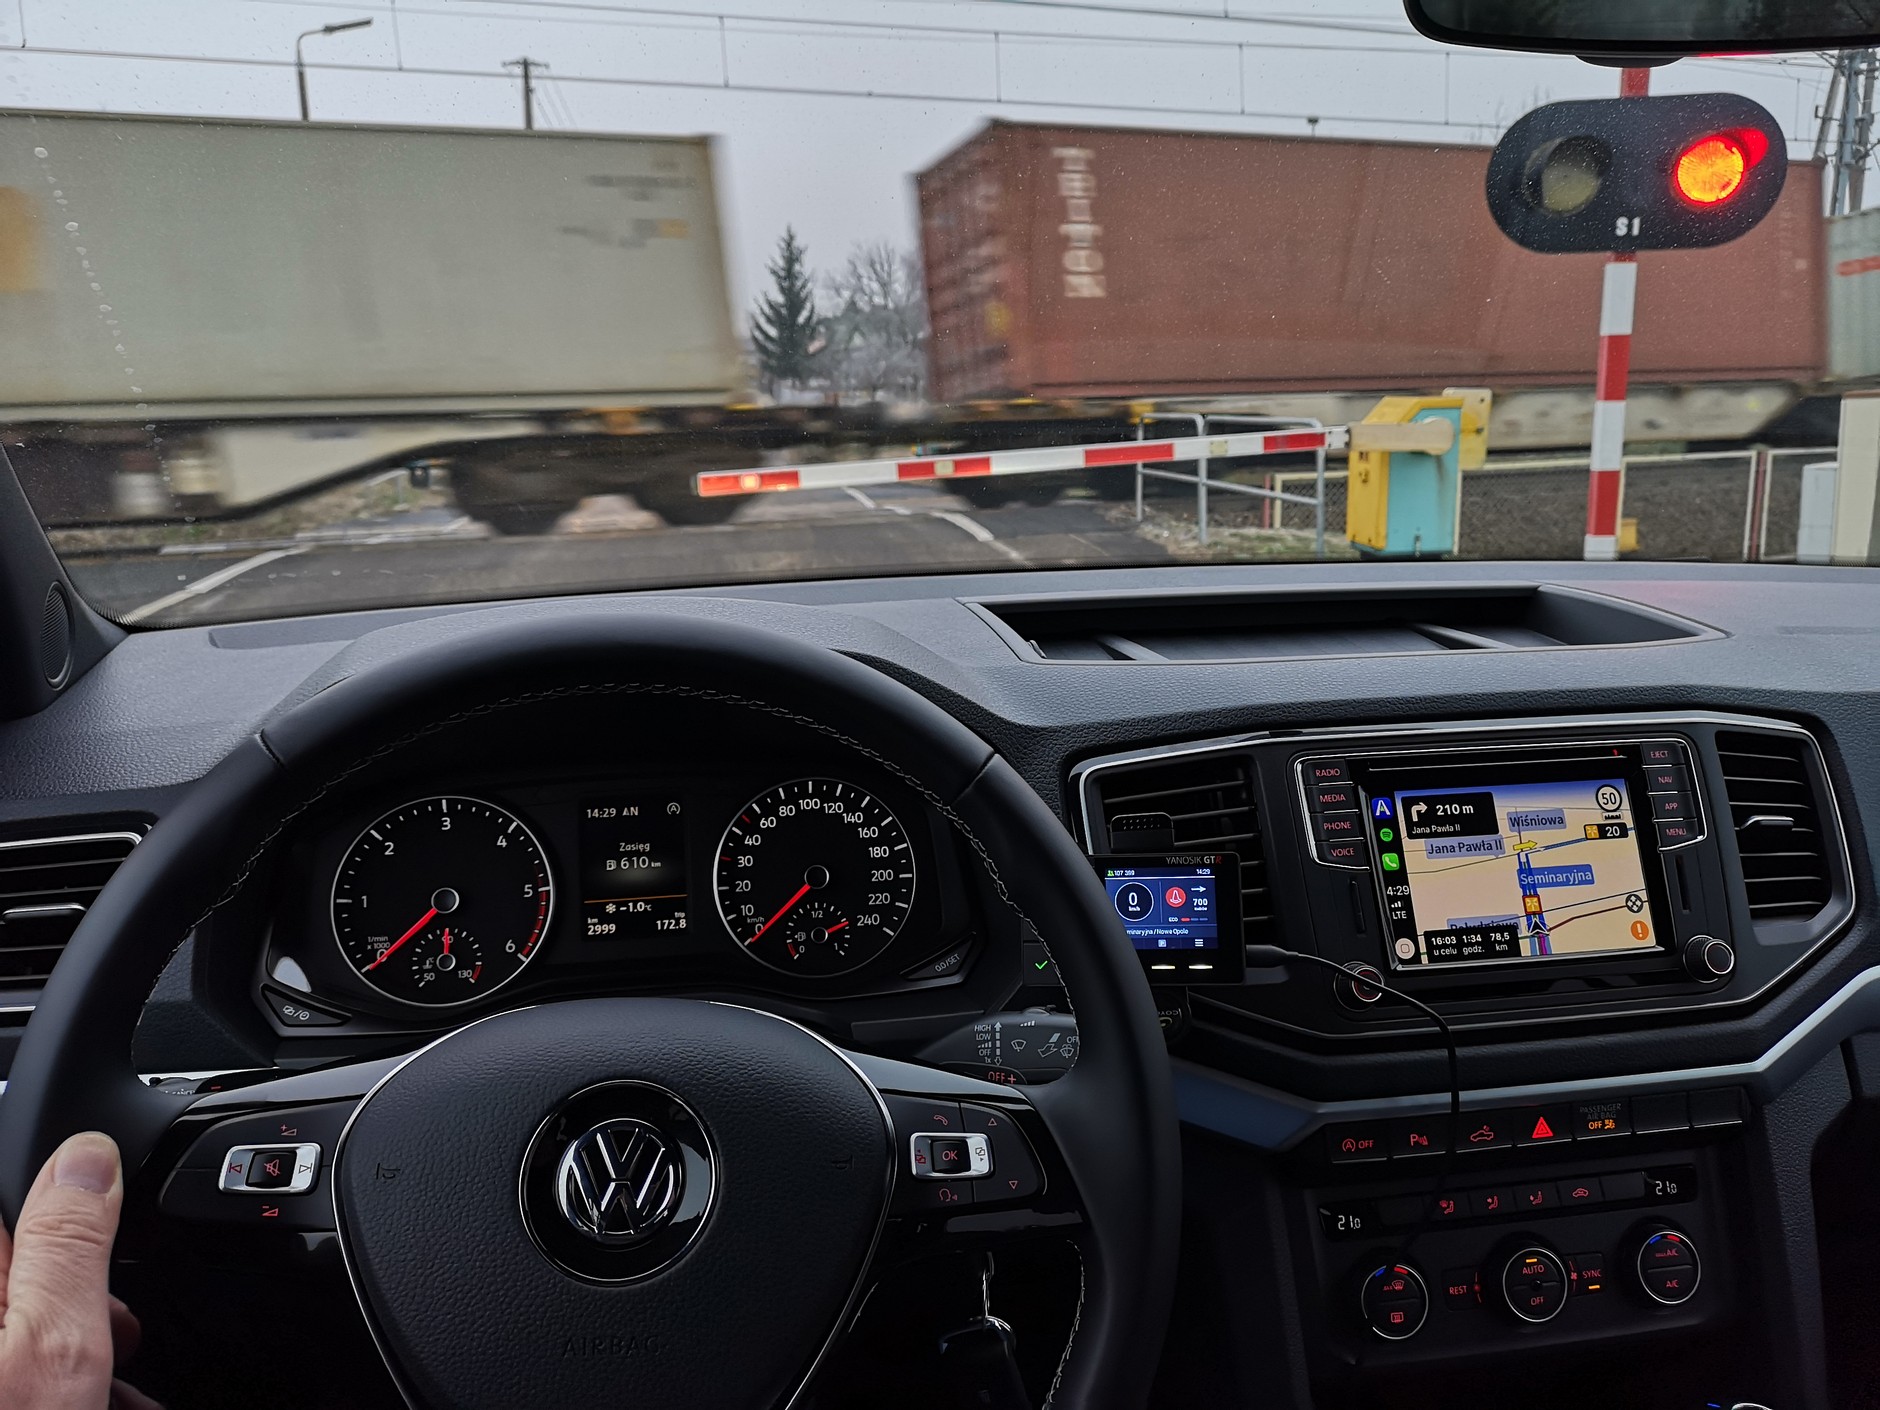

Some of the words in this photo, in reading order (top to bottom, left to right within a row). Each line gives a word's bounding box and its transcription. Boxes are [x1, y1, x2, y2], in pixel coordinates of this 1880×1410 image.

[1320, 794, 1346, 802] MEDIA
[1602, 793, 1617, 805] 50
[799, 799, 820, 809] 100
[823, 803, 843, 813] 120
[587, 808, 616, 818] 14:29
[779, 806, 795, 816] 80
[1436, 804, 1460, 815] 210
[1462, 805, 1474, 813] m
[760, 817, 776, 828] 60
[843, 813, 863, 823] 140
[1510, 815, 1564, 827] Wiśniowa
[442, 818, 450, 830] 3
[1324, 822, 1351, 830] PHONE
[858, 827, 878, 838] 160
[1412, 826, 1430, 834] Jana
[1606, 826, 1620, 836] 20
[1666, 828, 1686, 836] MENU
[497, 836, 507, 847] 4
[744, 835, 761, 845] 40
[385, 842, 394, 855] 2
[620, 842, 650, 852] Zasięg
[1428, 841, 1455, 854] Jana
[1459, 840, 1493, 852] Pawła
[1495, 839, 1502, 850] II
[869, 847, 889, 858] 180
[1331, 848, 1354, 856] VOICE
[621, 857, 649, 869] 610
[737, 856, 753, 867] 30
[1166, 856, 1201, 864] YANOSIK
[1204, 856, 1221, 864] GTR
[871, 870, 894, 881] 200
[1520, 870, 1592, 885] Seminaryjna
[524, 885, 532, 897] 5
[735, 881, 751, 892] 20
[1387, 885, 1409, 895] 4:29
[361, 896, 367, 907] 1
[869, 893, 890, 904] 220
[1129, 892, 1137, 905] 0
[741, 905, 754, 915] 10
[1393, 911, 1407, 919] LTE
[656, 919, 686, 930] 172.8
[857, 914, 880, 926] 240
[588, 924, 616, 935] 2999
[755, 924, 764, 934] 0
[1431, 936, 1456, 945] 16:03
[1462, 934, 1482, 943] 1:34
[1490, 932, 1509, 942] 78,5
[506, 940, 515, 952] 6
[799, 945, 805, 953] 0
[1440, 947, 1457, 955] celu
[1463, 946, 1485, 956] godz.
[377, 949, 387, 962] 0
[458, 970, 472, 978] 130
[1580, 1103, 1621, 1113] PASSENGER
[1600, 1111, 1616, 1119] BAG
[1588, 1121, 1603, 1130] OFF
[1358, 1140, 1374, 1148] OFF
[942, 1150, 958, 1161] OK
[1656, 1181, 1677, 1195] 21.0
[1338, 1215, 1361, 1230] 21.0
[1522, 1264, 1544, 1274] AUTO
[1582, 1270, 1602, 1278] SYNC
[1450, 1286, 1467, 1294] REST
[1531, 1296, 1544, 1305] OFF
